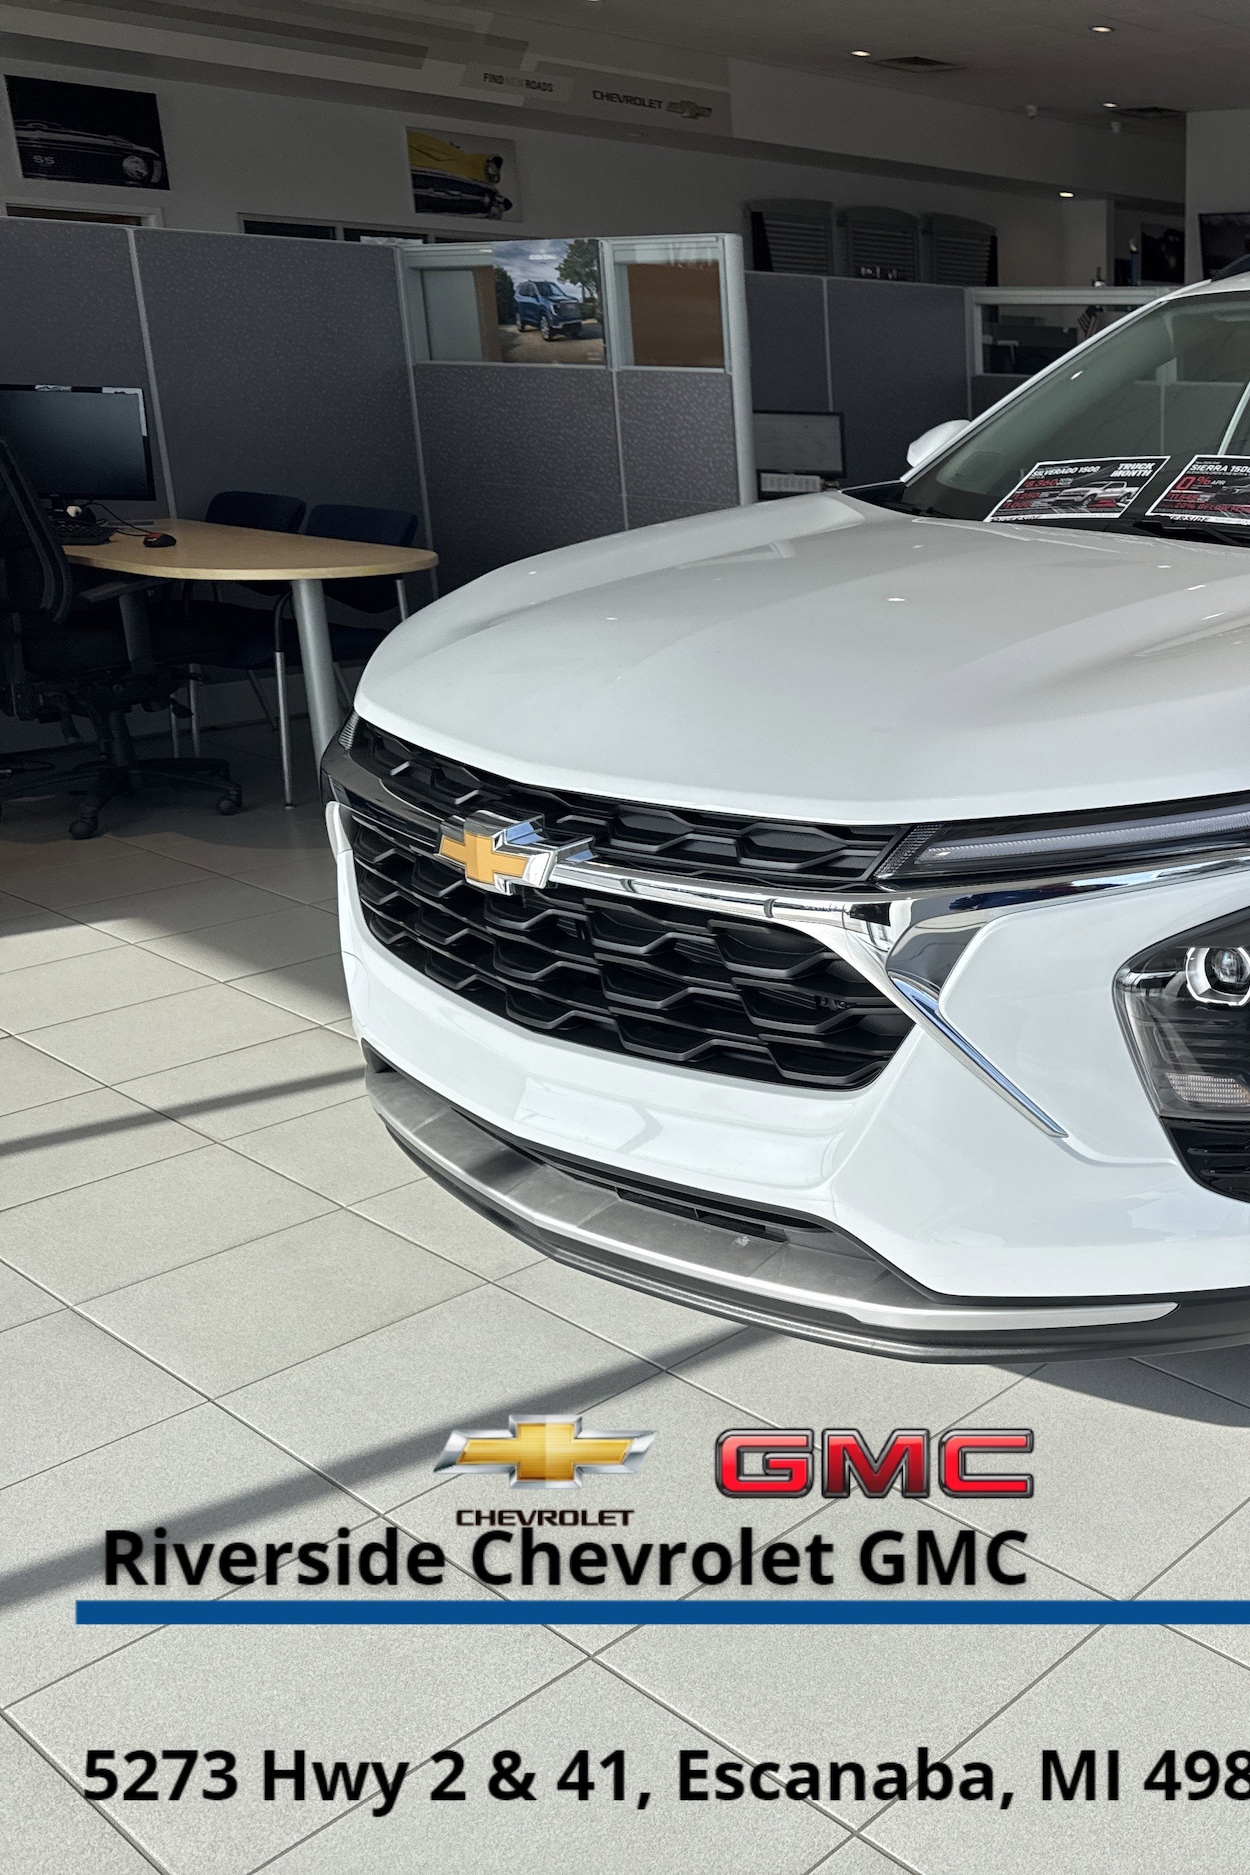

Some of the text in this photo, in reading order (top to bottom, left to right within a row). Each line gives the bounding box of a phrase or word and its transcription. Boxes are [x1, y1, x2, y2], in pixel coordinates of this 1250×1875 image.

[483, 72, 504, 85] FIND
[525, 79, 554, 93] ROADS
[592, 90, 663, 110] CHEVROLET
[33, 155, 55, 165] SS
[1031, 467, 1079, 477] SILVERADO
[1078, 465, 1101, 474] 1500
[1117, 462, 1156, 470] TRUCK
[1189, 463, 1229, 473] SIERRA
[1110, 469, 1154, 477] MONTH
